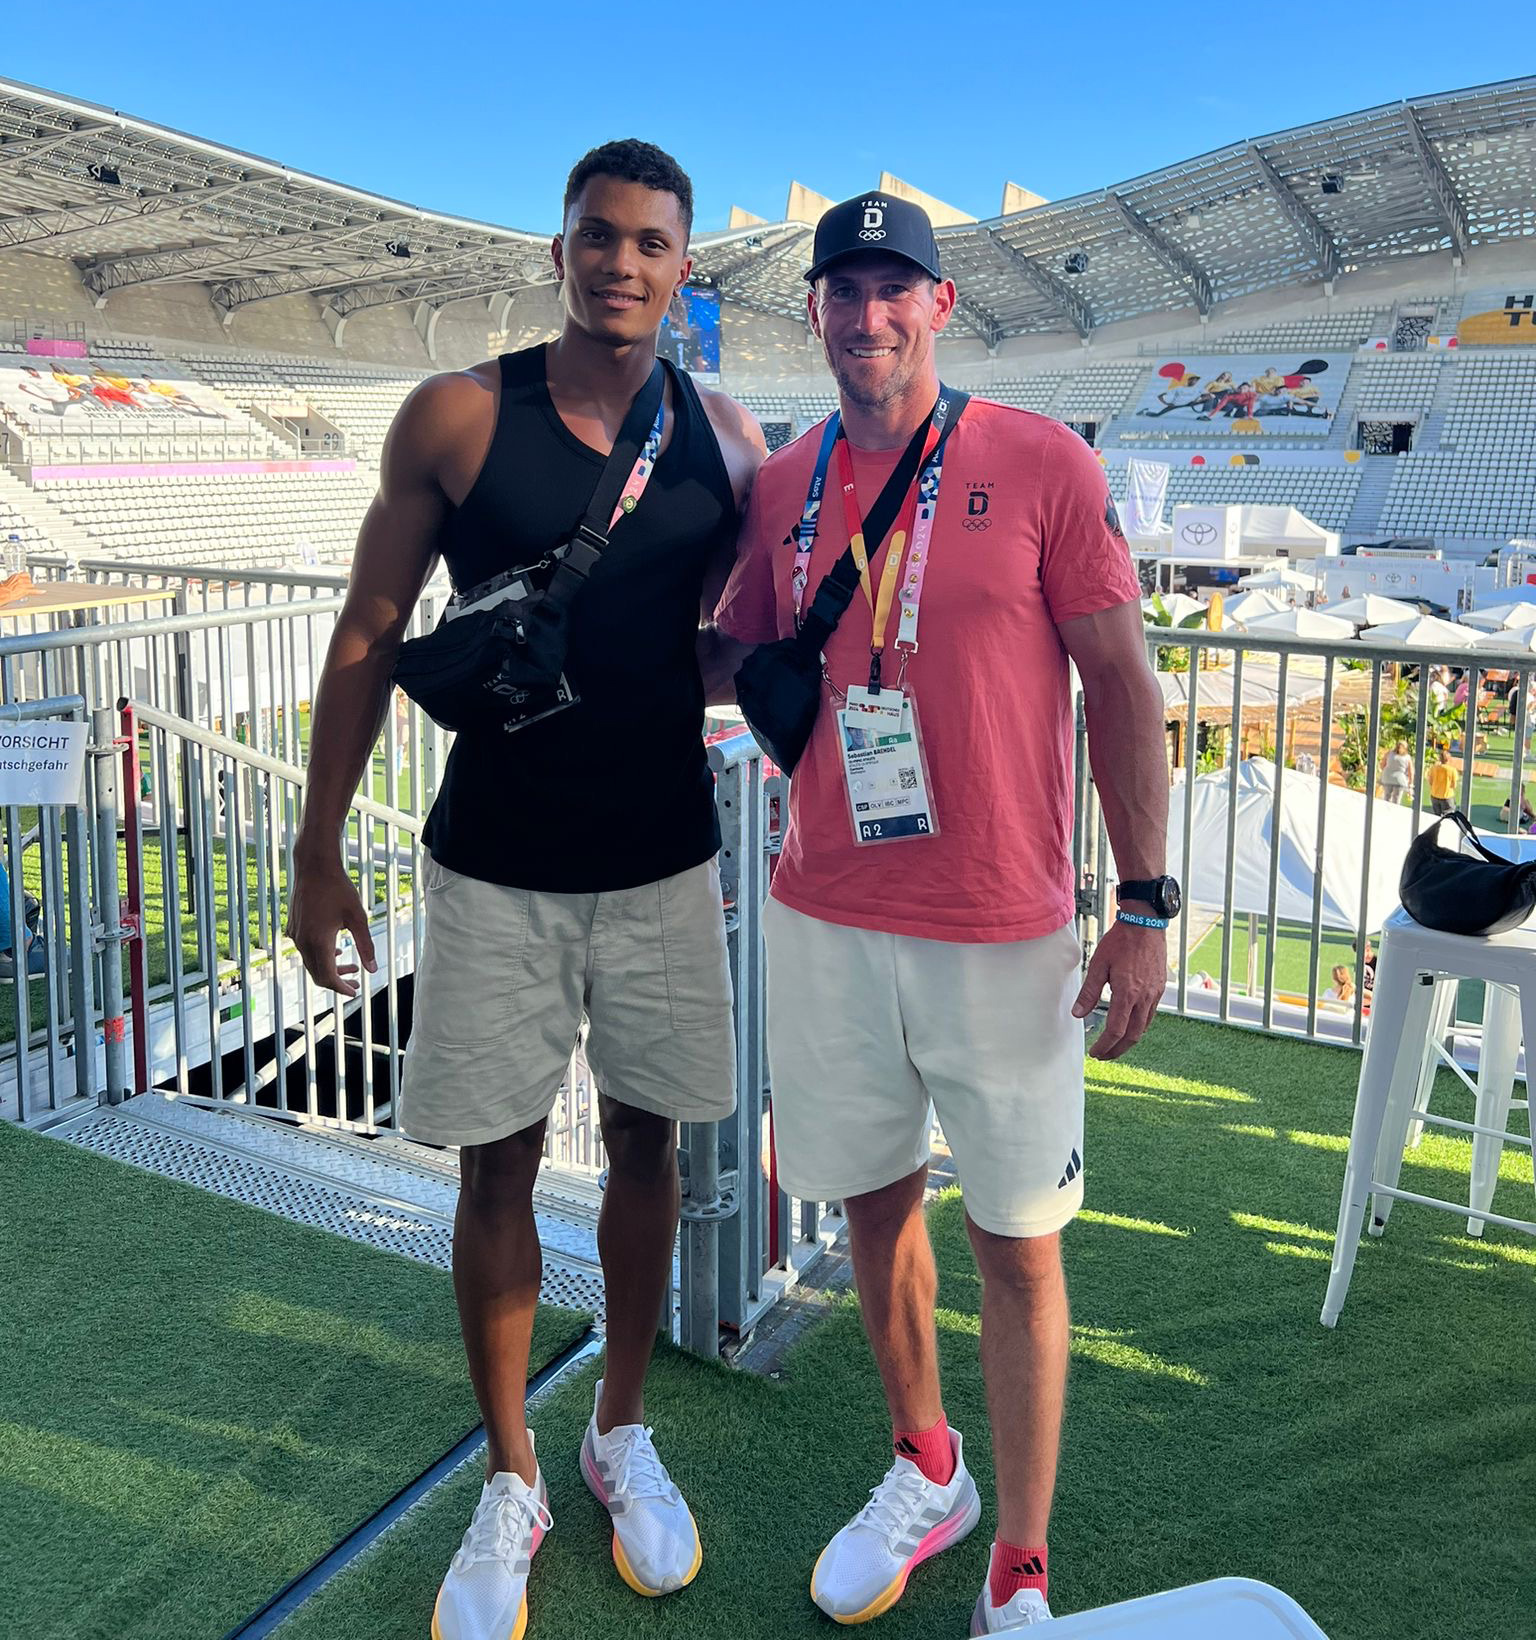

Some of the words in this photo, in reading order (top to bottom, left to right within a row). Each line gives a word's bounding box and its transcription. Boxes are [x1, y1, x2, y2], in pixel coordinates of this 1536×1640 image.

[863, 208, 883, 228] D
[968, 491, 989, 516] D
[873, 823, 883, 836] 2
[917, 818, 927, 831] R
[1120, 912, 1144, 925] PARIS
